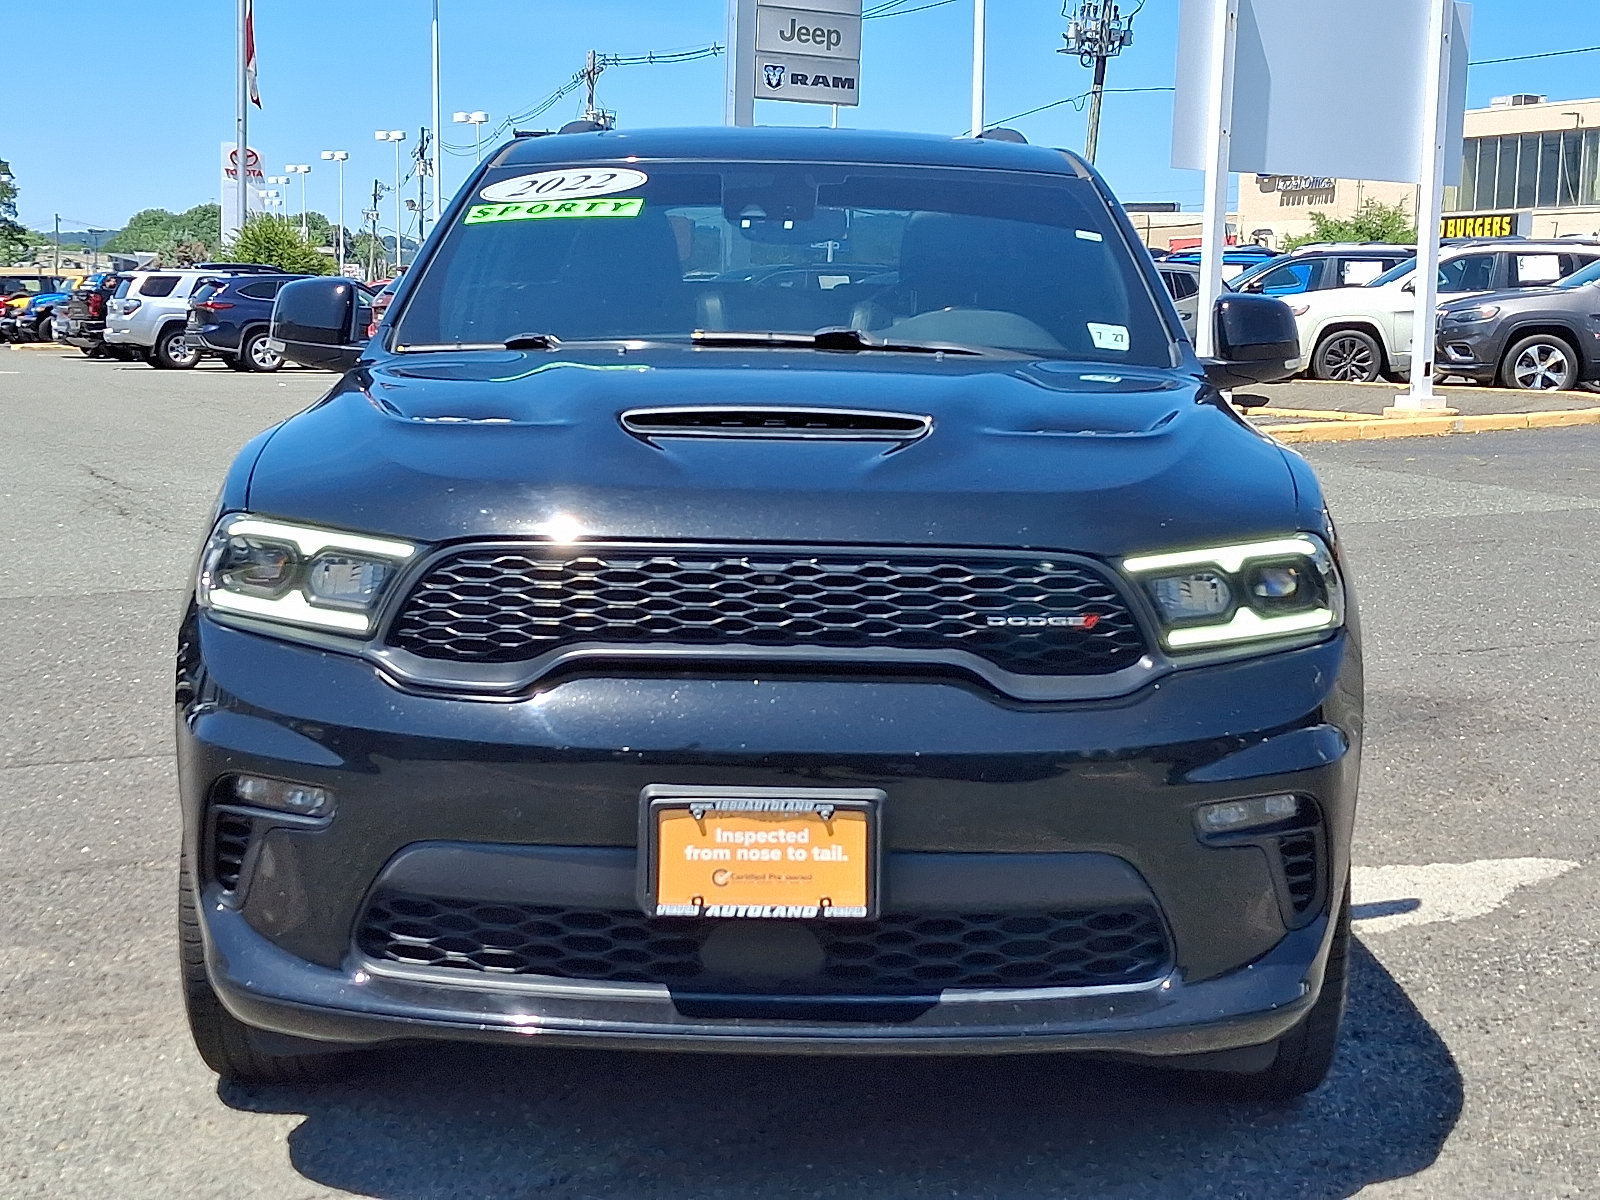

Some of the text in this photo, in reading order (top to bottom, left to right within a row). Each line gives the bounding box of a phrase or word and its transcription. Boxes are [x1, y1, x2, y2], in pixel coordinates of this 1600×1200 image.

[779, 18, 841, 51] Jeep
[790, 72, 855, 90] RAM
[224, 168, 264, 177] TOOTA
[507, 173, 618, 197] 2022
[472, 201, 633, 219] SPORTY
[1446, 216, 1511, 238] BURGERS
[986, 616, 1085, 626] DODGE
[715, 827, 810, 846] Inspected
[684, 844, 849, 861] from nose to tail.
[705, 904, 818, 919] AUTOLAND
